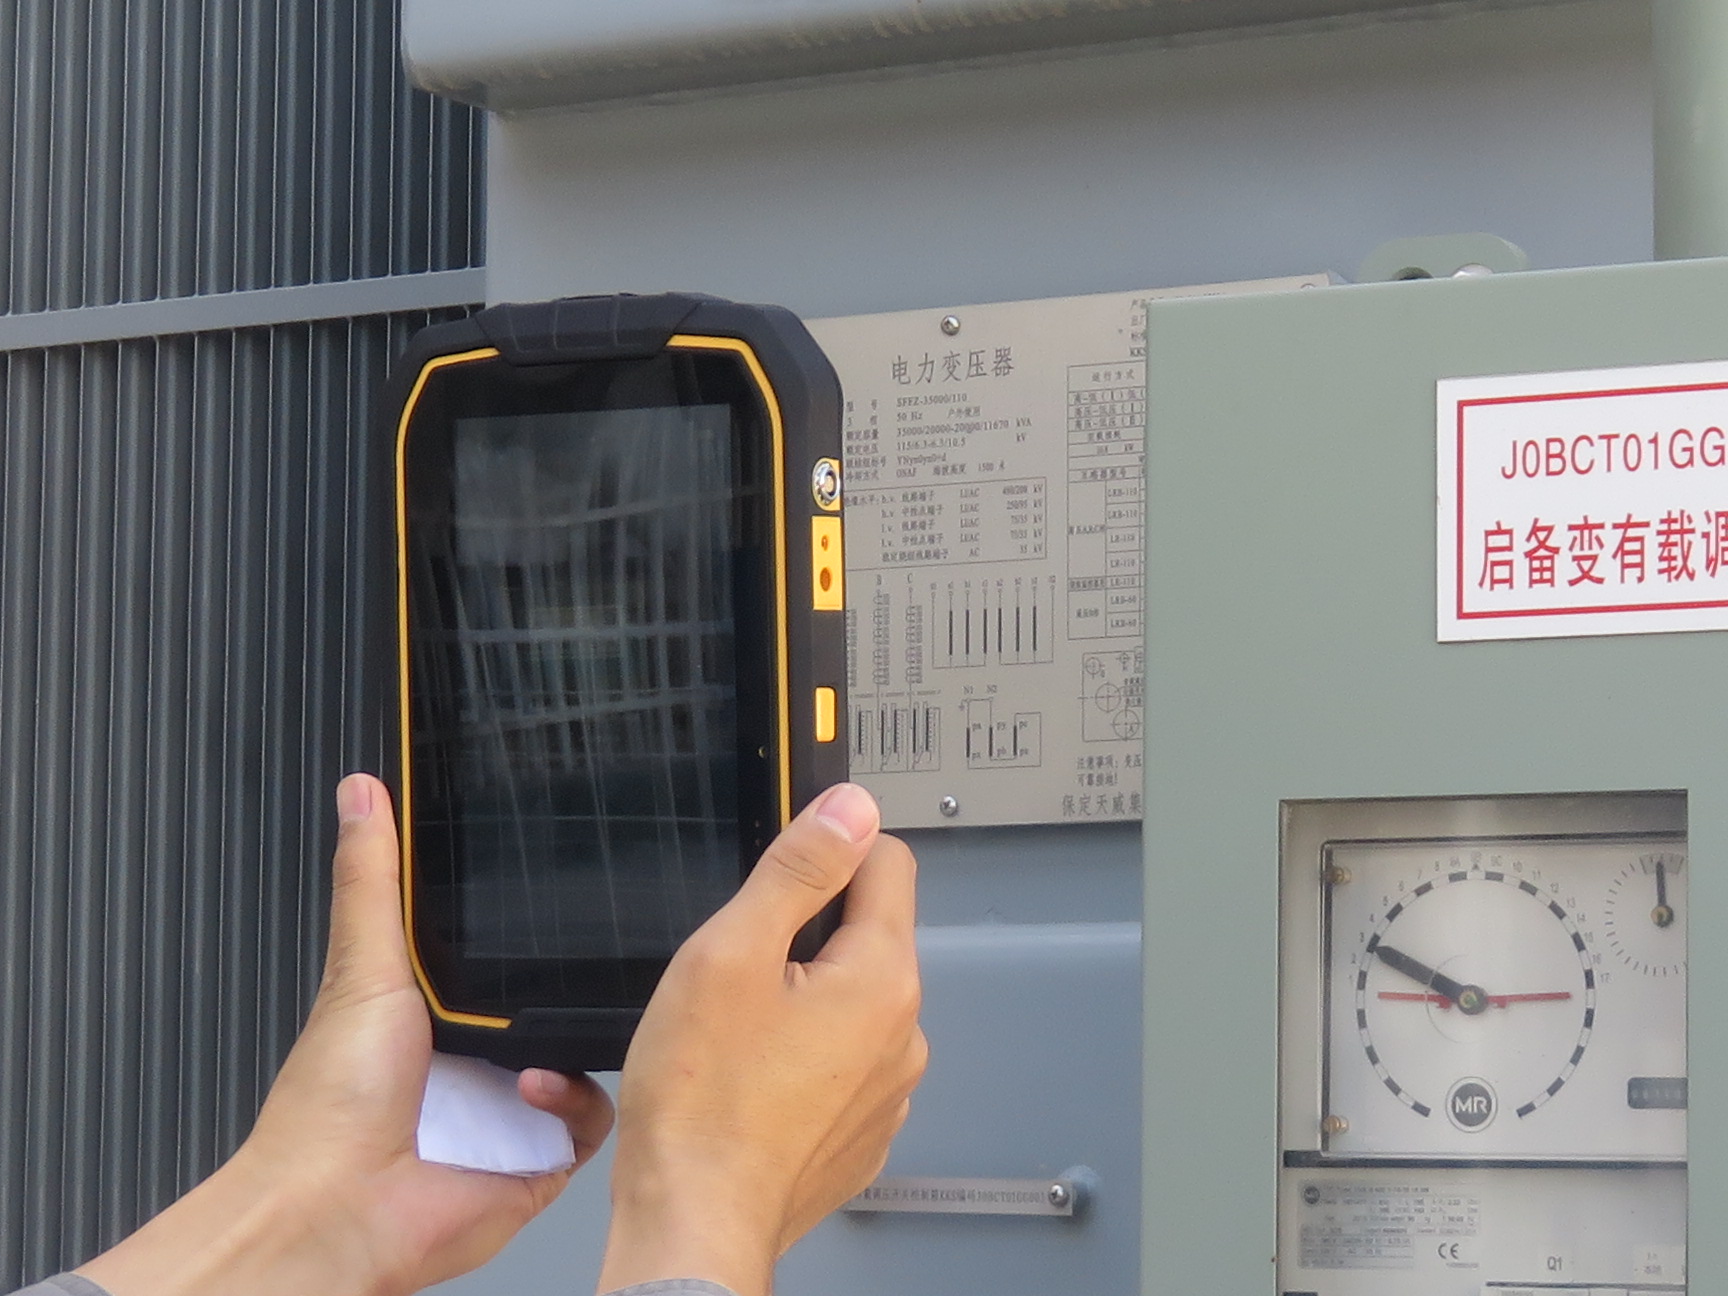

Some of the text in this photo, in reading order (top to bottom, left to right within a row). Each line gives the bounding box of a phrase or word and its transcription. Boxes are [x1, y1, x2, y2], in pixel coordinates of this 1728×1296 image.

[891, 345, 1015, 385] 电力变压器
[1454, 1095, 1491, 1116] MR
[1438, 1242, 1459, 1259] CE
[1547, 1256, 1562, 1271] Q1
